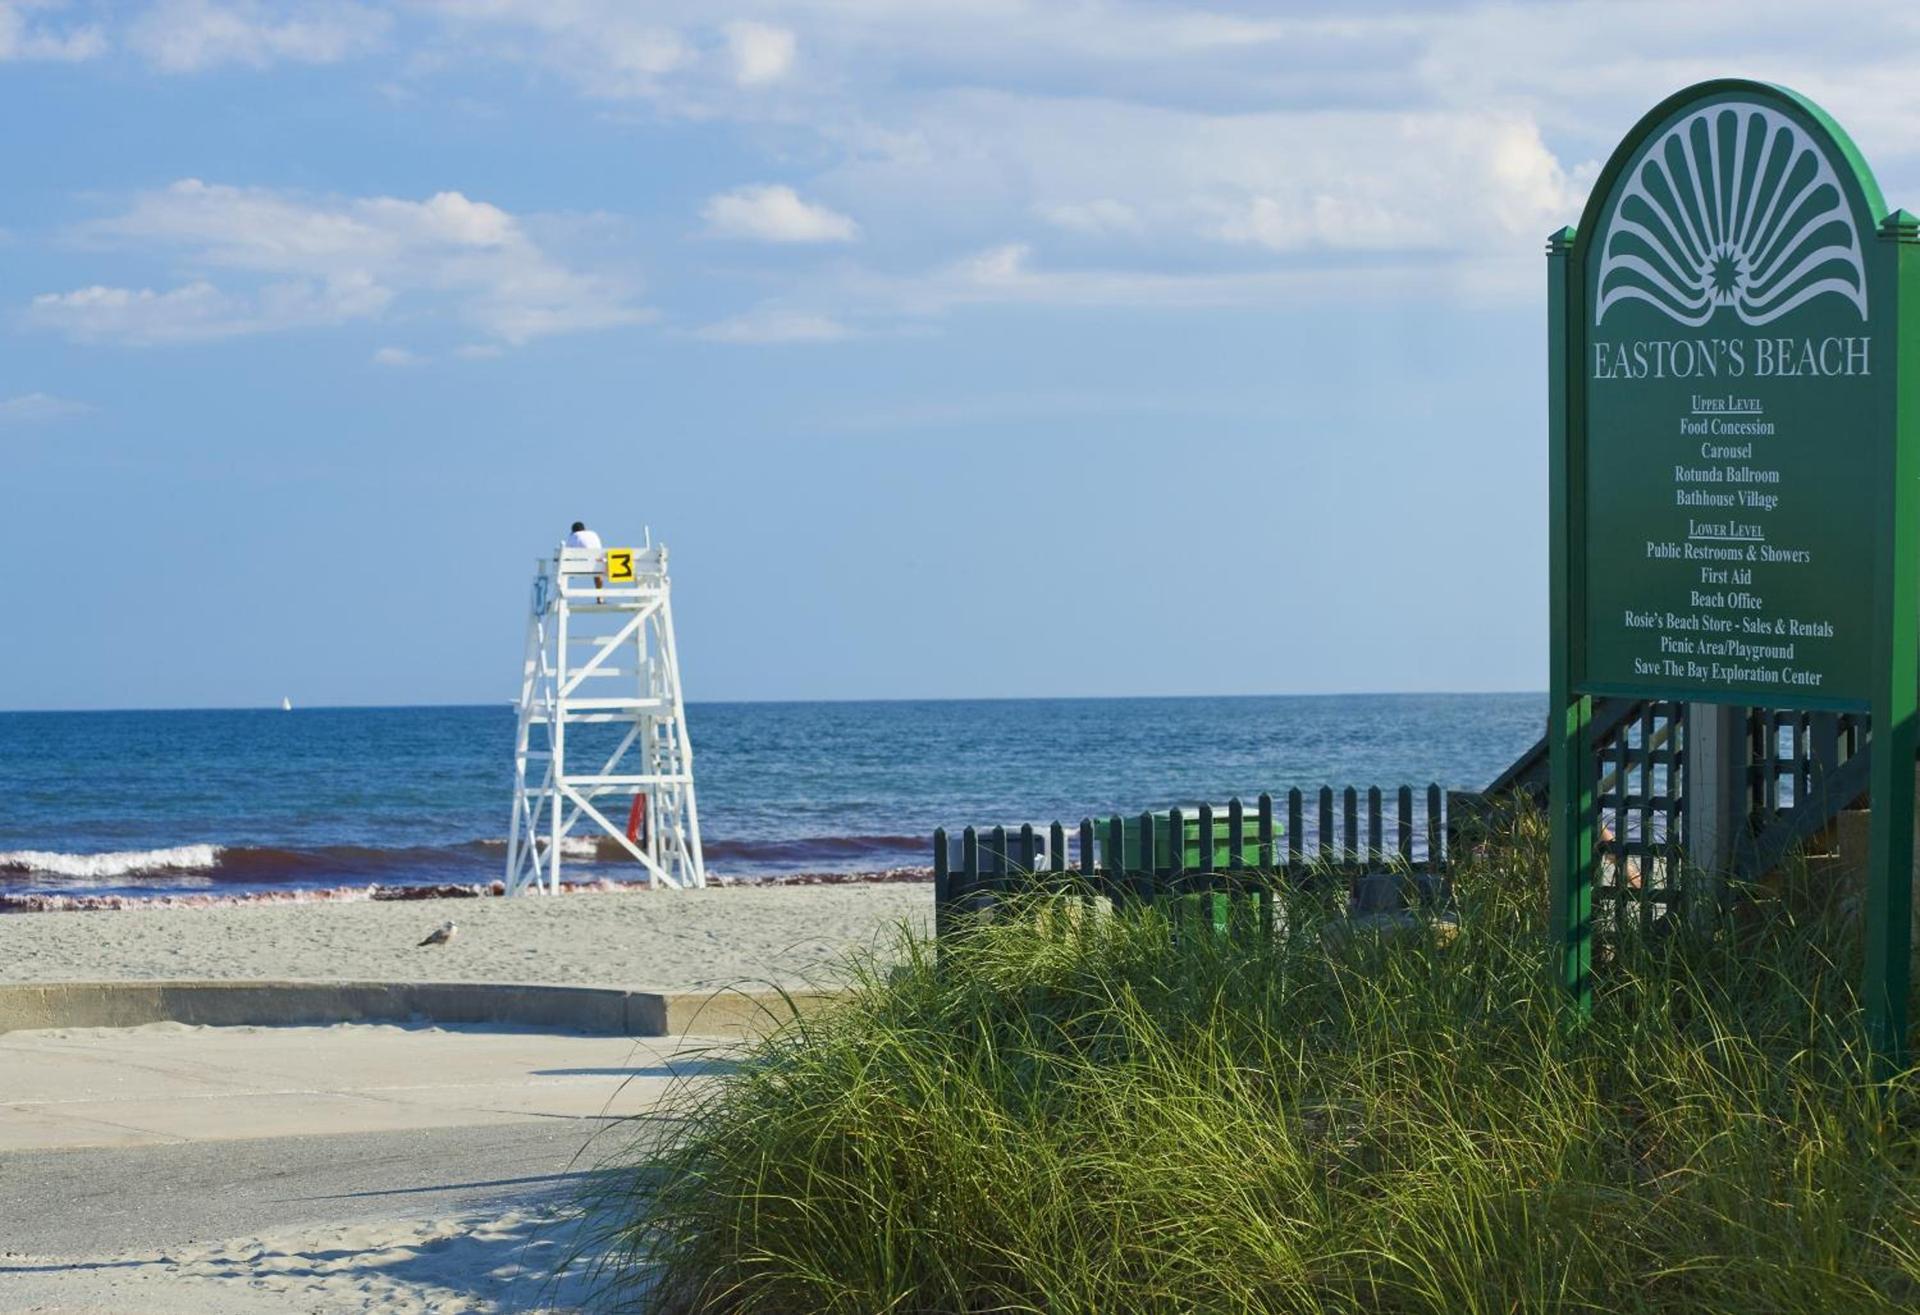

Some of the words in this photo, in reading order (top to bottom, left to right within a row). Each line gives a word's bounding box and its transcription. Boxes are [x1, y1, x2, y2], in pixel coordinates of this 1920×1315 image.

[1593, 339, 1745, 378] EASTON'S
[1754, 337, 1871, 376] BEACH
[1681, 418, 1708, 434] Food
[1711, 419, 1774, 435] Concession
[1701, 443, 1751, 458] Carousel
[1675, 466, 1723, 482] Rotunda
[1727, 467, 1779, 483] Ballroom
[1677, 490, 1735, 505] Bathhouse
[1737, 491, 1778, 511] Village
[1647, 542, 1681, 558] Public
[1684, 544, 1742, 560] Restrooms
[1746, 546, 1756, 560] &
[1760, 545, 1810, 563] Showers
[611, 554, 632, 577] 3
[1701, 567, 1727, 583] First
[1731, 569, 1751, 584] Aid
[1691, 591, 1724, 607] Beach
[1728, 592, 1762, 609] Office
[1625, 611, 1664, 628] Rosie's
[1667, 613, 1699, 630] Beach
[1702, 615, 1732, 631] Store
[1743, 617, 1772, 634] Sales
[1775, 619, 1785, 634] &
[1790, 619, 1834, 637] Rentals
[1661, 636, 1694, 654] Picnic
[1697, 638, 1794, 661] Area/Playground
[1635, 658, 1660, 674] Save
[1663, 660, 1684, 676] The
[1688, 662, 1708, 682] Bay
[1712, 663, 1779, 683] Exploration
[1782, 667, 1822, 685] Center
